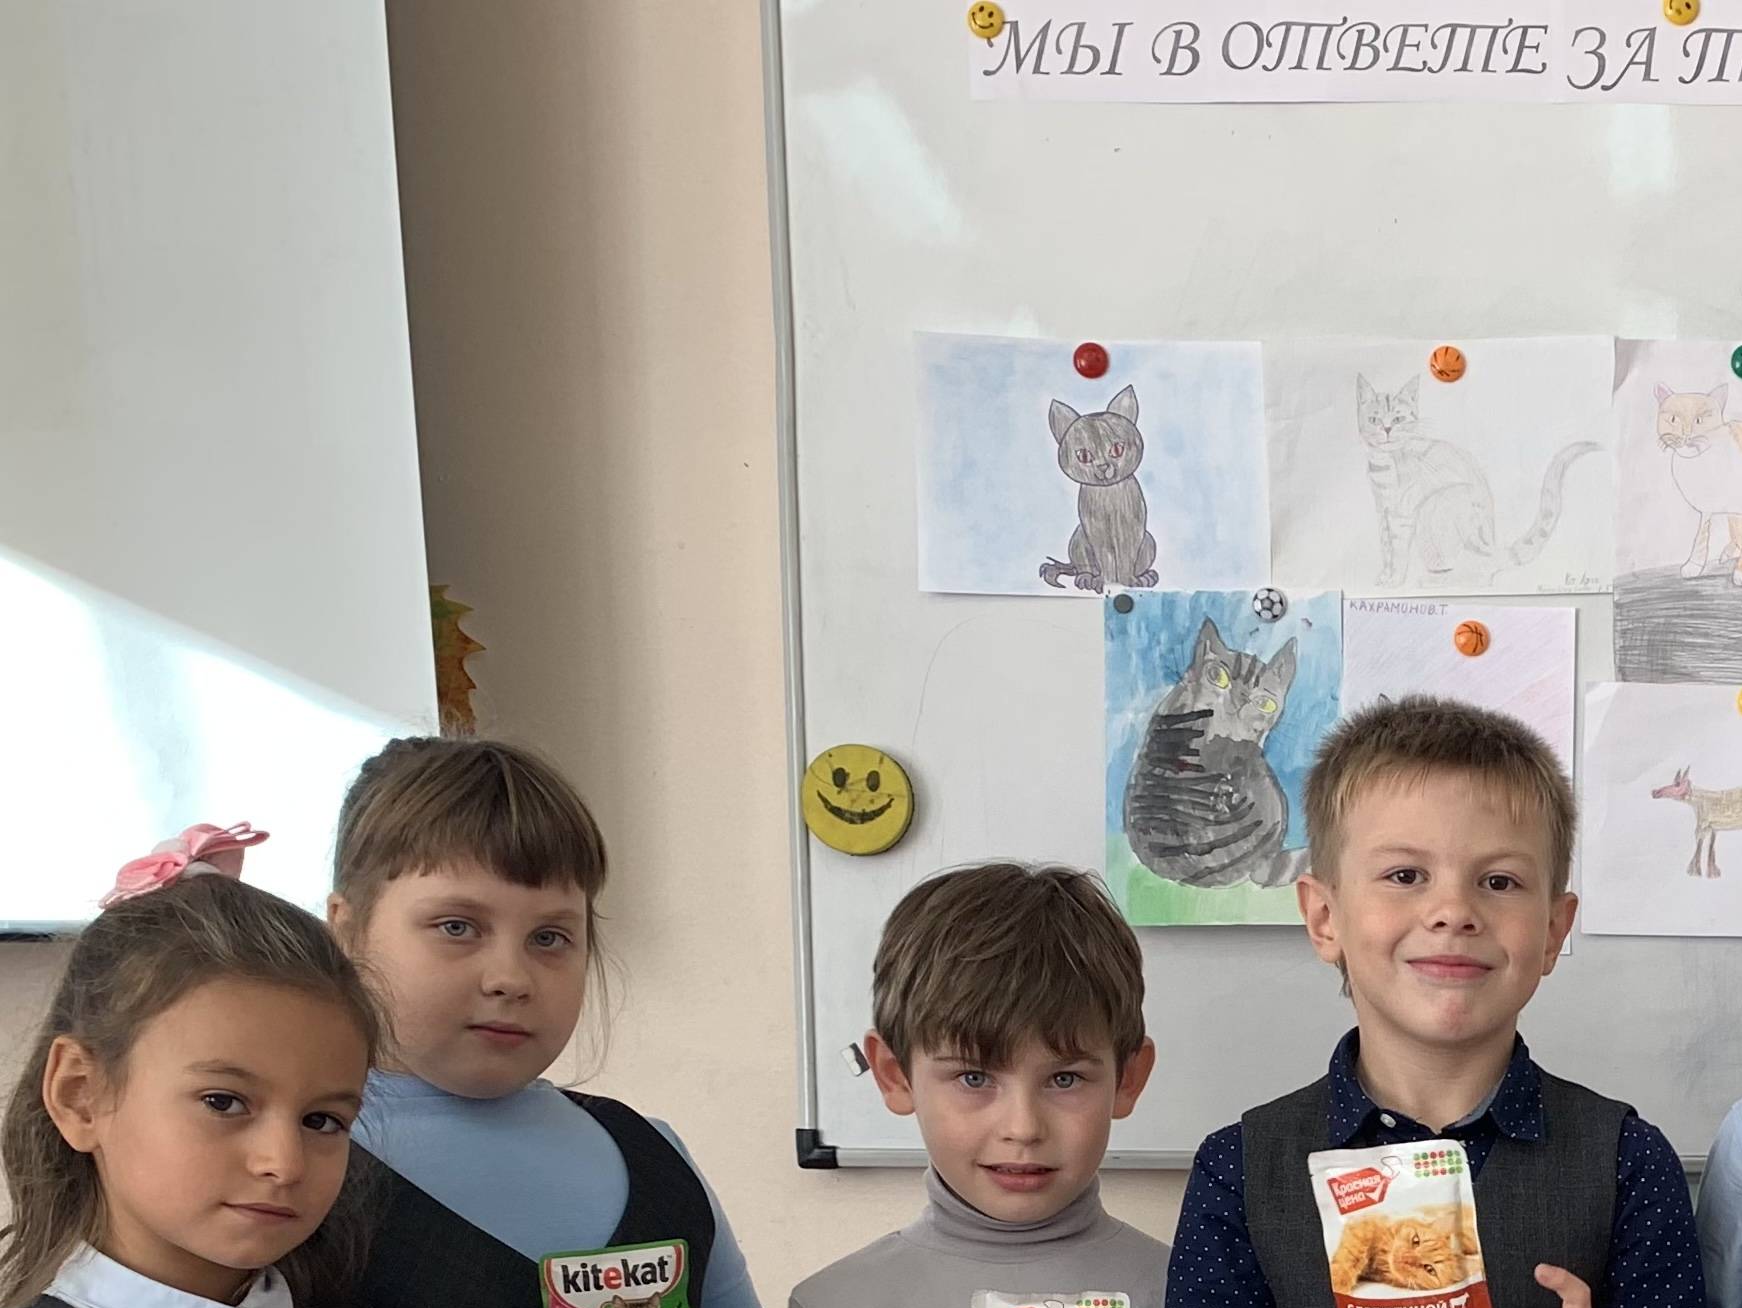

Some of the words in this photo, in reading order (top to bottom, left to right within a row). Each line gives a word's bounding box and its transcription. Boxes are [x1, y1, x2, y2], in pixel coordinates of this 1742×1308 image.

[984, 21, 1133, 77] МЫ
[1151, 25, 1202, 77] В
[1220, 16, 1549, 75] ОТВЕТЕ
[1566, 26, 1660, 91] ЗА
[561, 1255, 670, 1294] kitekat
